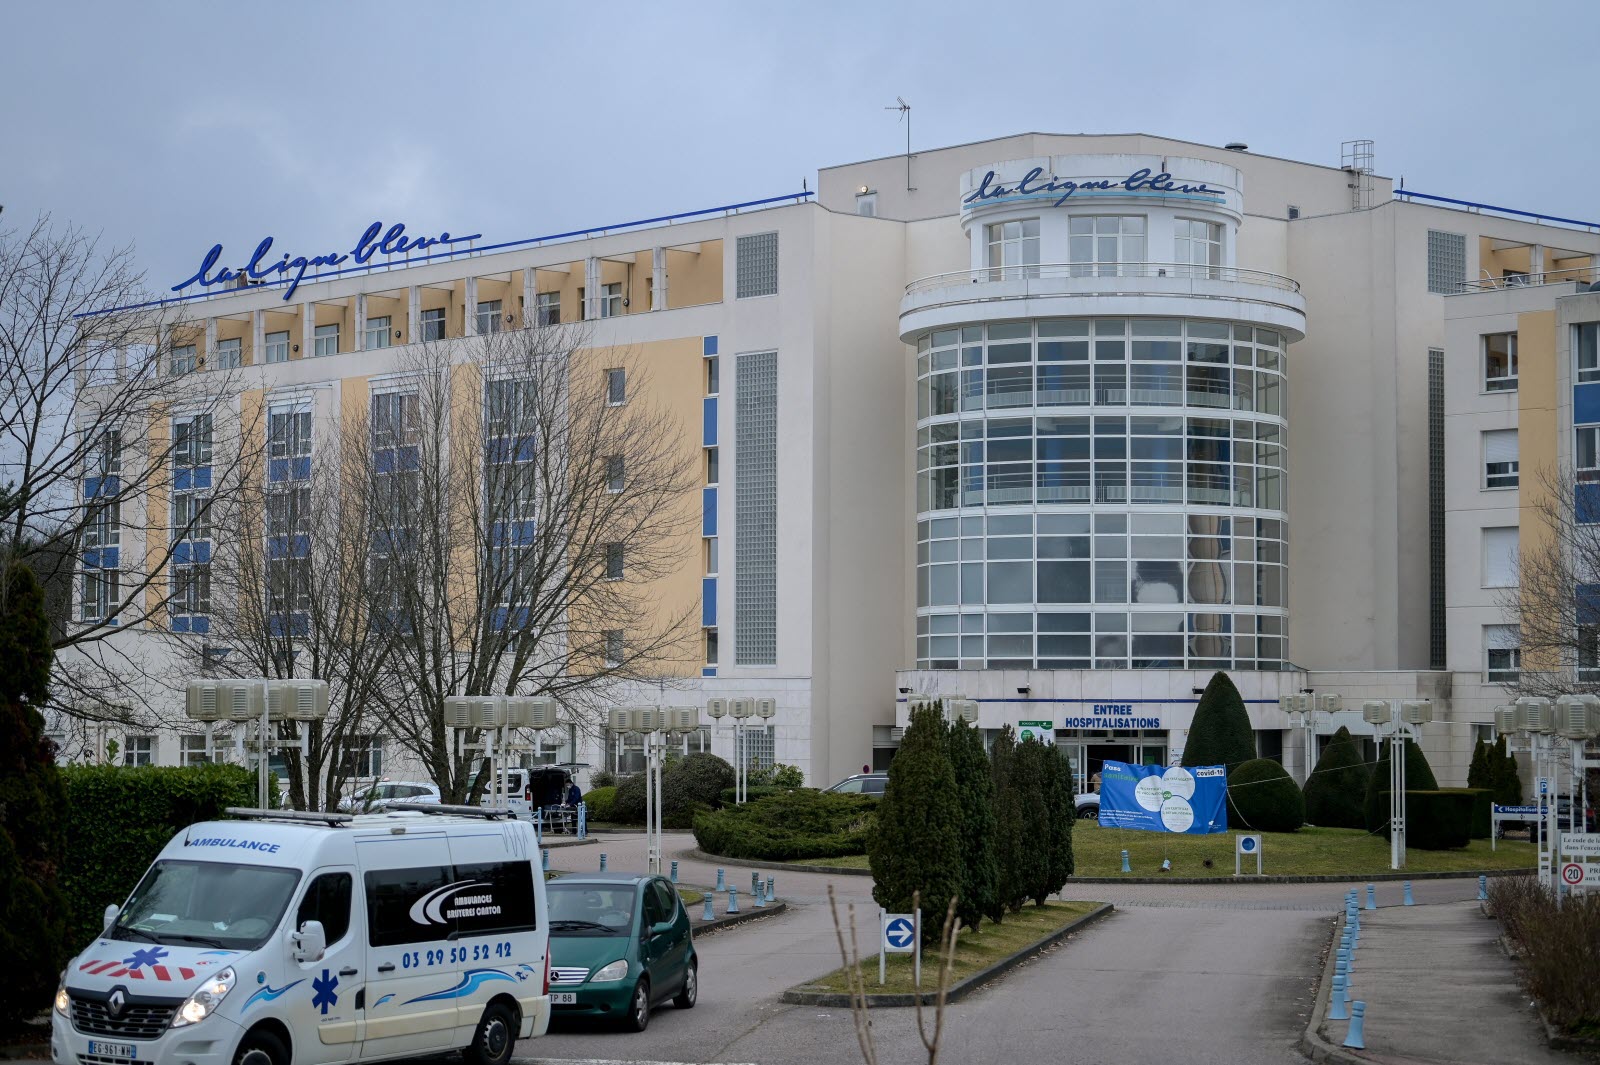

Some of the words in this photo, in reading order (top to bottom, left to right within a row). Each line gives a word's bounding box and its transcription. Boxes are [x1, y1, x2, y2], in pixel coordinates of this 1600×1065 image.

[1093, 704, 1132, 715] ENTREE
[1065, 717, 1160, 728] HOSPITALISATIONS
[1104, 763, 1121, 772] Pass
[1196, 769, 1224, 777] covid-19
[189, 838, 280, 853] AMBULANCE
[1567, 868, 1579, 879] 20
[454, 894, 492, 906] AMBULANCES
[446, 908, 476, 919] BRUYERES
[476, 905, 501, 916] CANTON
[402, 951, 419, 969] 03
[427, 949, 444, 966] 29
[450, 947, 467, 963] 50
[473, 944, 489, 961] 52
[495, 941, 511, 958] 42
[562, 994, 572, 1003] 88
